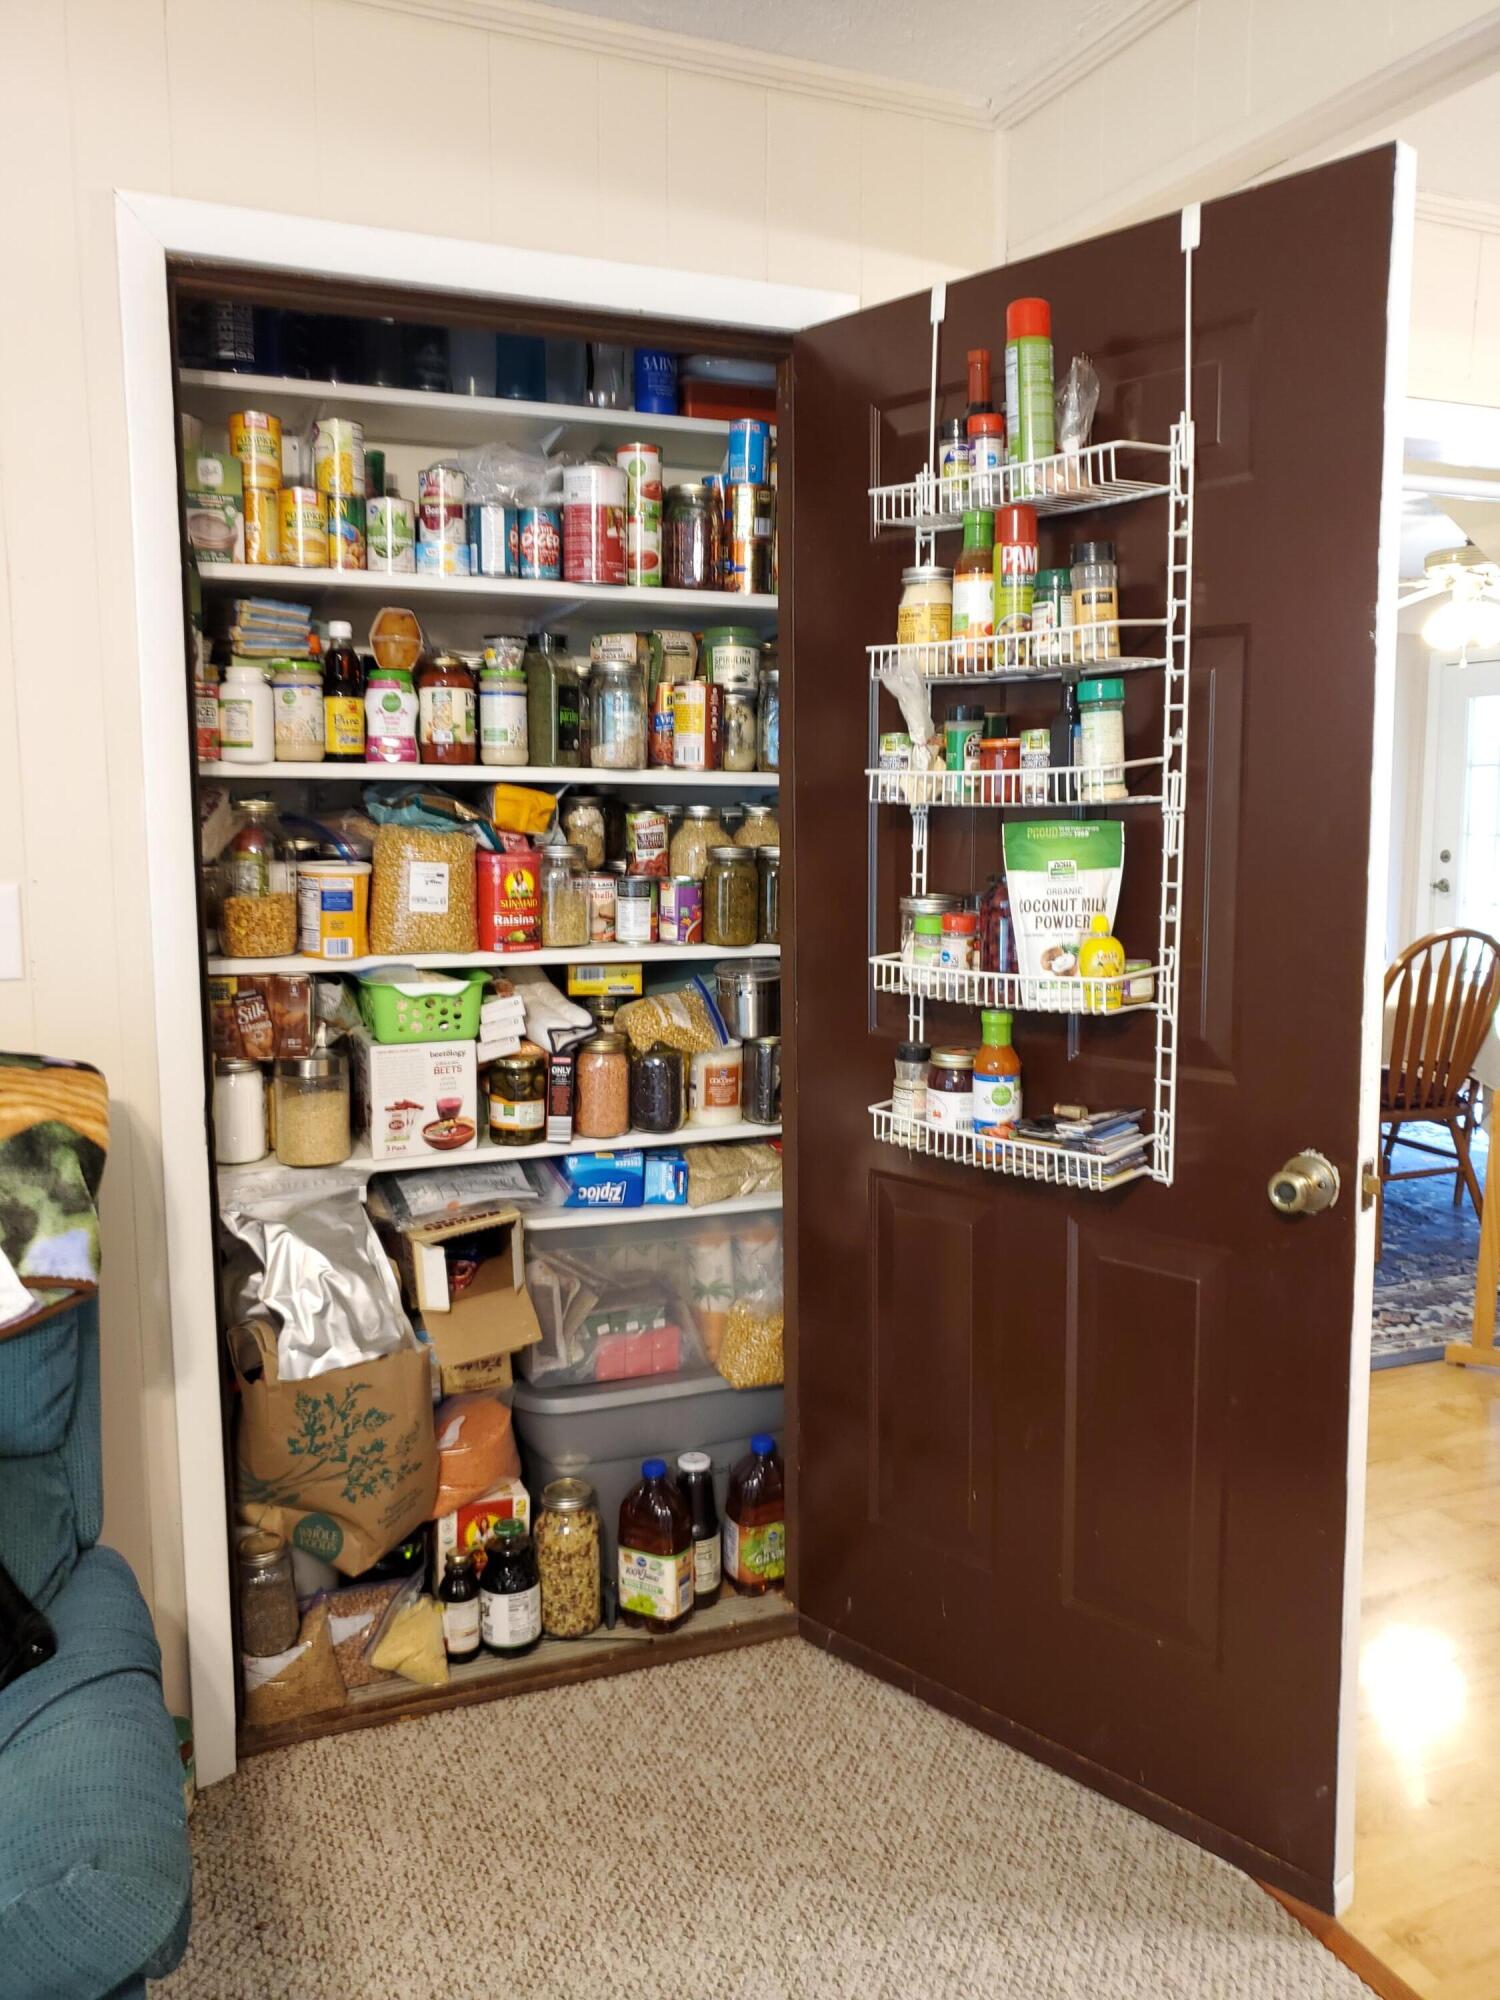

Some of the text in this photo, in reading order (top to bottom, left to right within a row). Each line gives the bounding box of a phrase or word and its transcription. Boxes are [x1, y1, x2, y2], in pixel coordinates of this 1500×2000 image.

[1002, 545, 1038, 574] PAM
[1027, 826, 1058, 840] PROUD
[1046, 887, 1083, 896] ORGANIC
[1019, 896, 1108, 914] COCONUT MILK
[494, 914, 534, 926] Raisins
[1035, 913, 1090, 930] POWDER
[238, 1001, 266, 1024] Silk
[433, 1065, 463, 1075] BEETS
[551, 1065, 571, 1076] ONLY
[578, 1181, 624, 1202] Ziploc
[299, 1527, 337, 1541] WHOLE
[299, 1536, 337, 1552] FOODS
